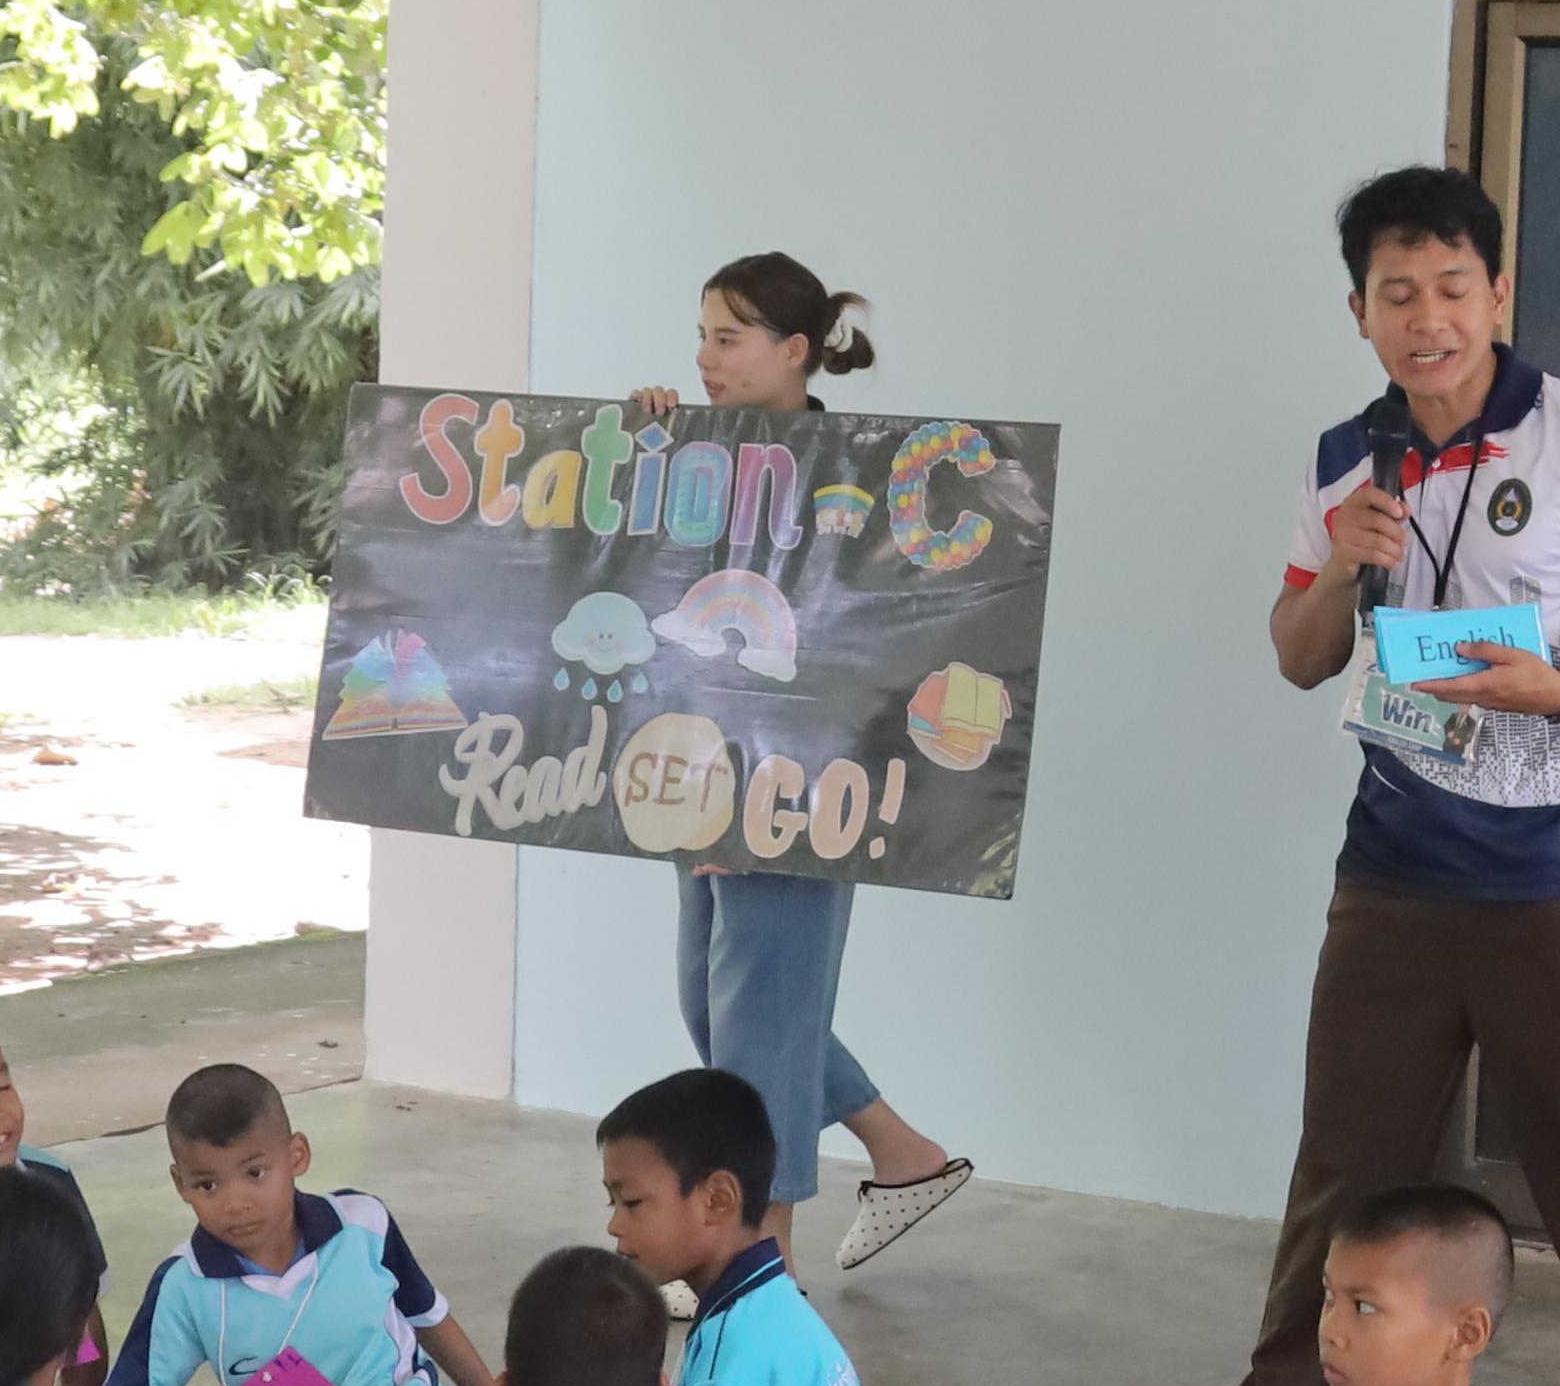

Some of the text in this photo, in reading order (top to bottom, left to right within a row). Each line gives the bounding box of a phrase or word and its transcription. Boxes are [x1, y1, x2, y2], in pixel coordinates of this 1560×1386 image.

[398, 392, 805, 550] Station
[438, 703, 907, 862] Read SET GO!
